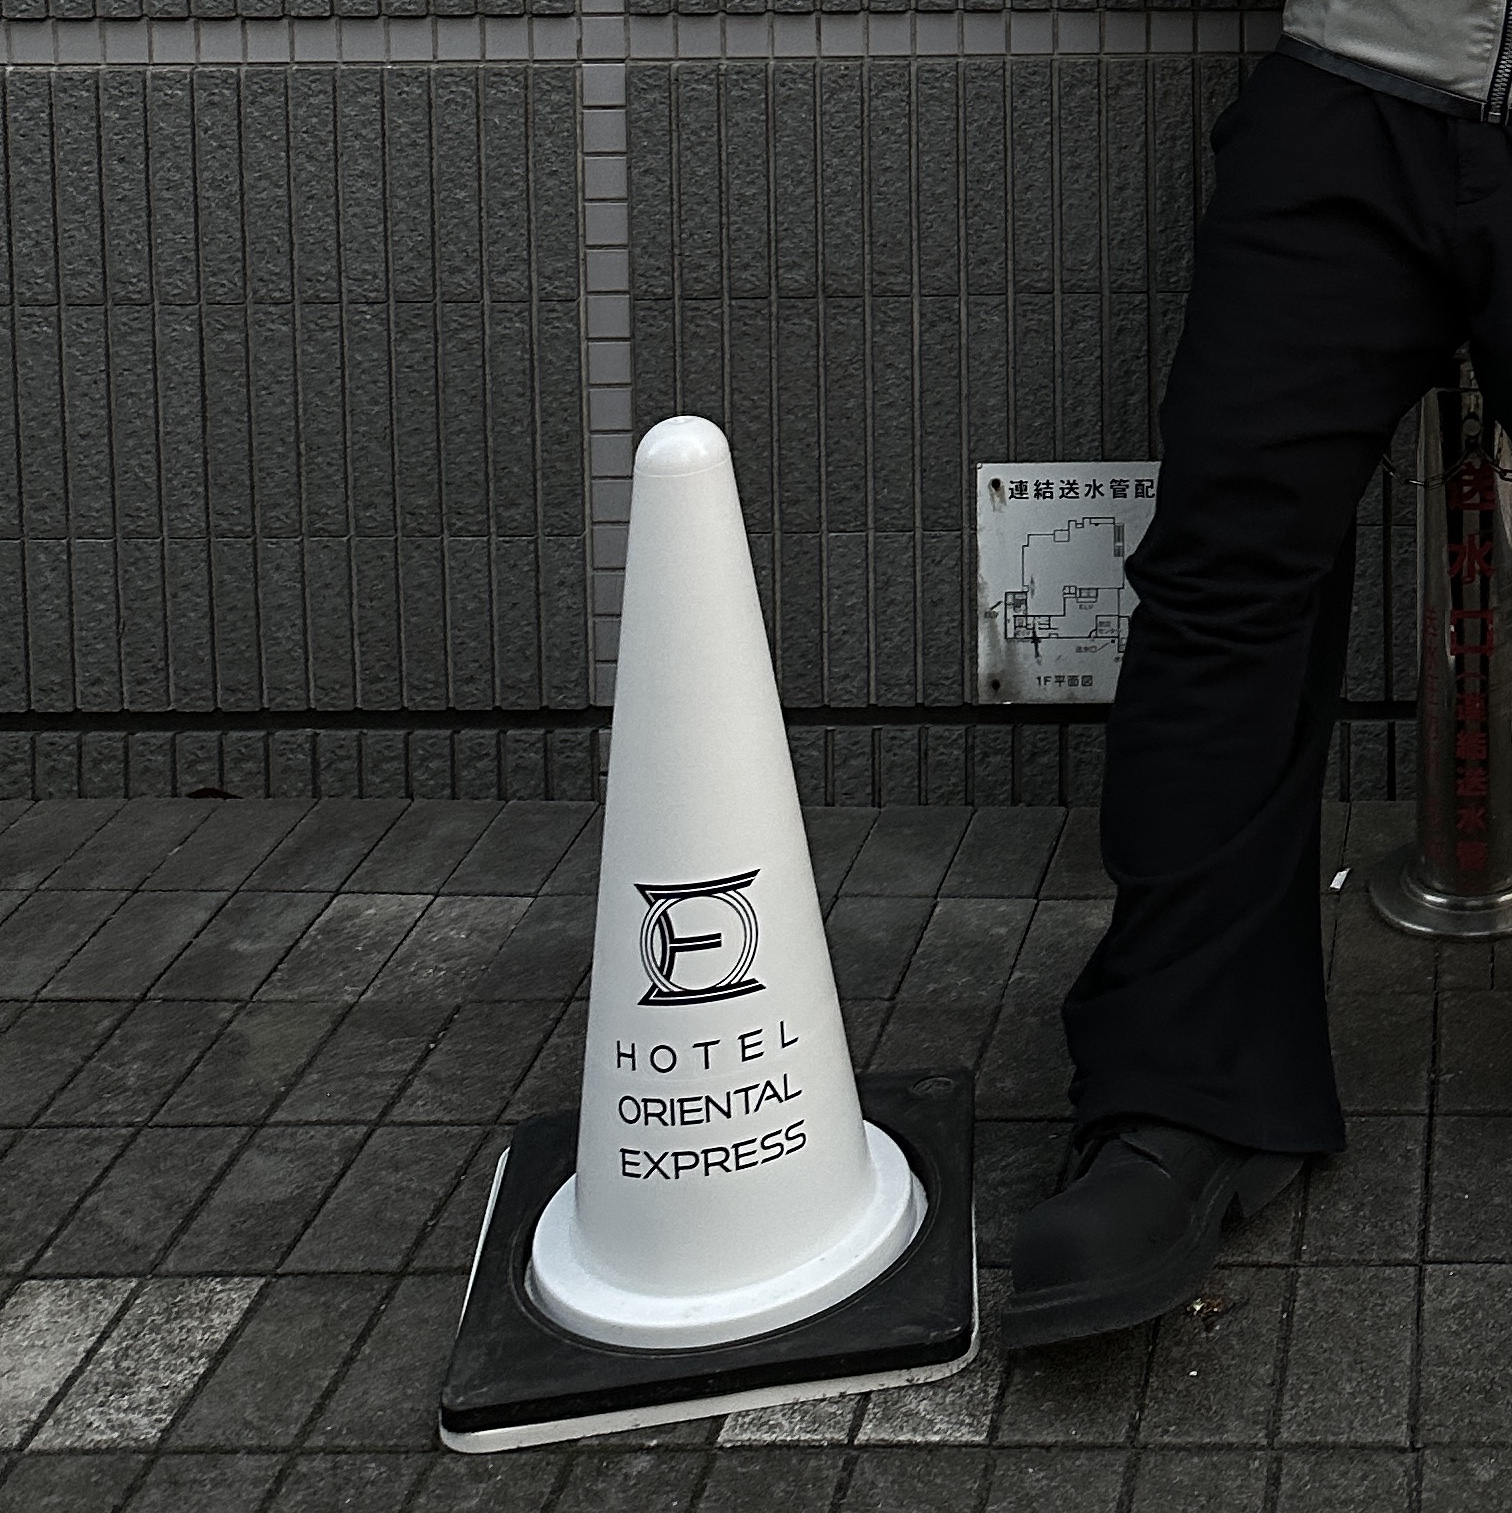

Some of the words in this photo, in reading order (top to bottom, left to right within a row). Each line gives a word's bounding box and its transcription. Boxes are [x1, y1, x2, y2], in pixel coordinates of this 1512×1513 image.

[1008, 478, 1156, 500] 連結送水管配
[616, 1020, 799, 1073] HOTEL
[618, 1073, 802, 1126] ORIENTAL
[619, 1119, 807, 1180] EXPRESS
